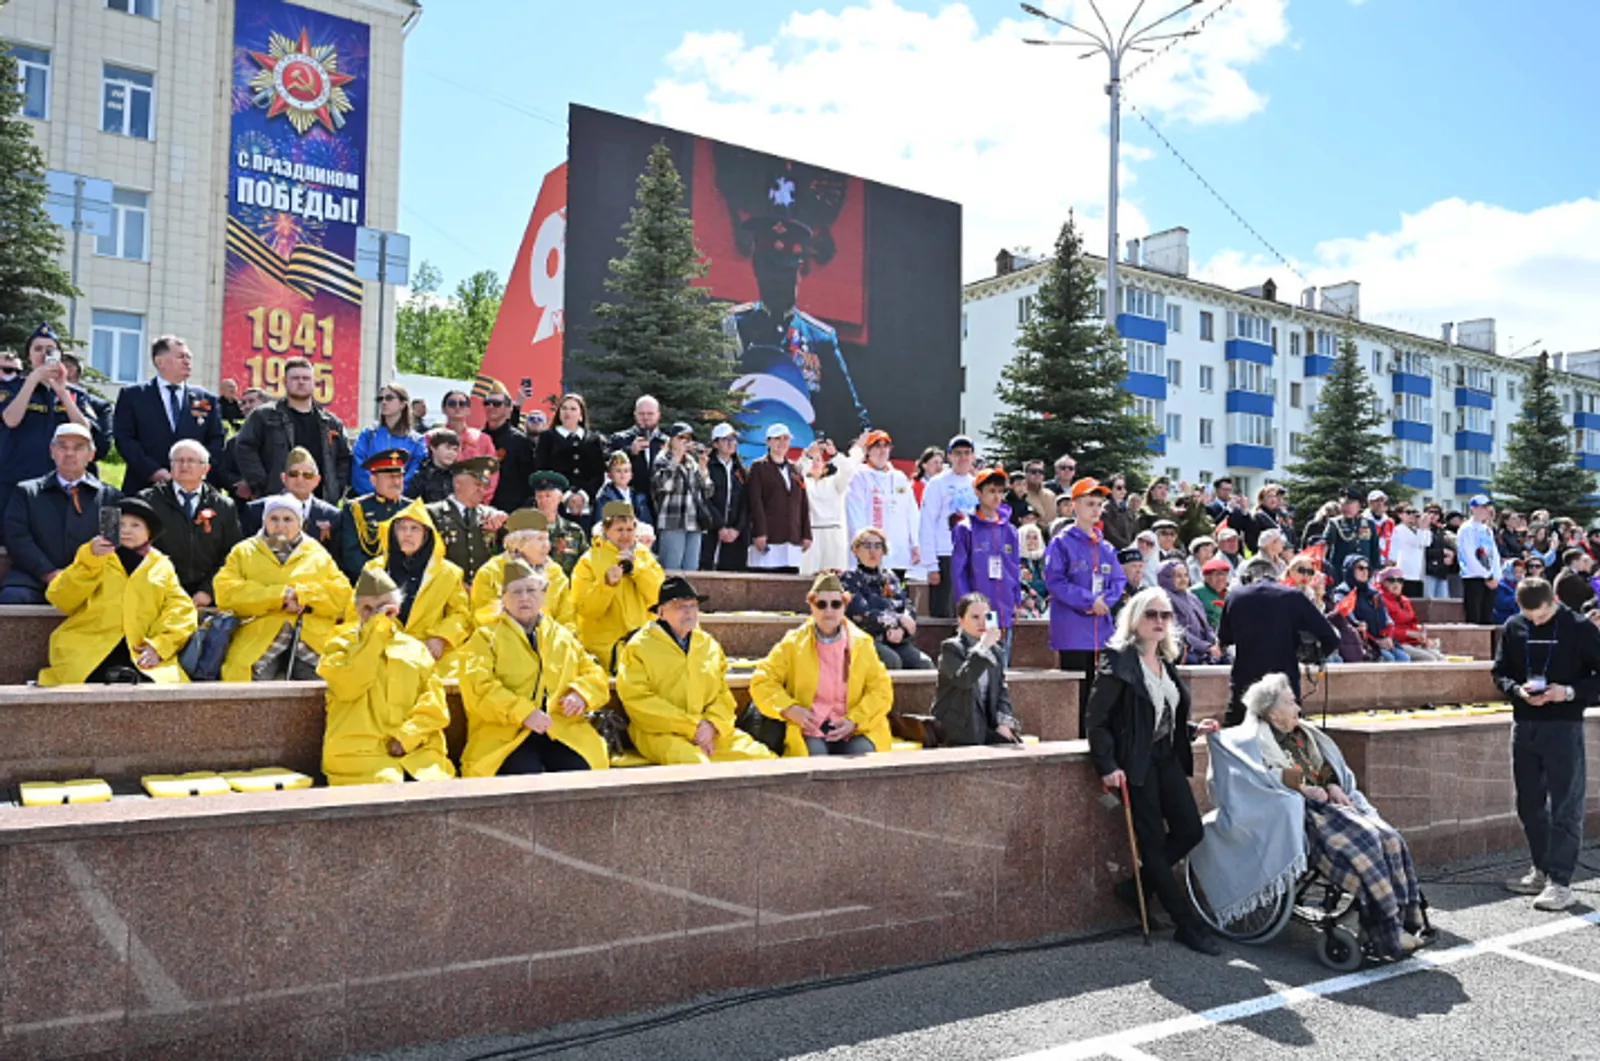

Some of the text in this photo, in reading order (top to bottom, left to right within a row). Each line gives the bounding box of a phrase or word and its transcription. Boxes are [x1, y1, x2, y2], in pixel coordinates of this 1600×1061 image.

[237, 151, 359, 190] С ПРАЗДНИКОМ
[237, 176, 359, 223] ПОБЕДЫ!
[247, 306, 335, 358] 1941
[245, 355, 335, 404] 195
